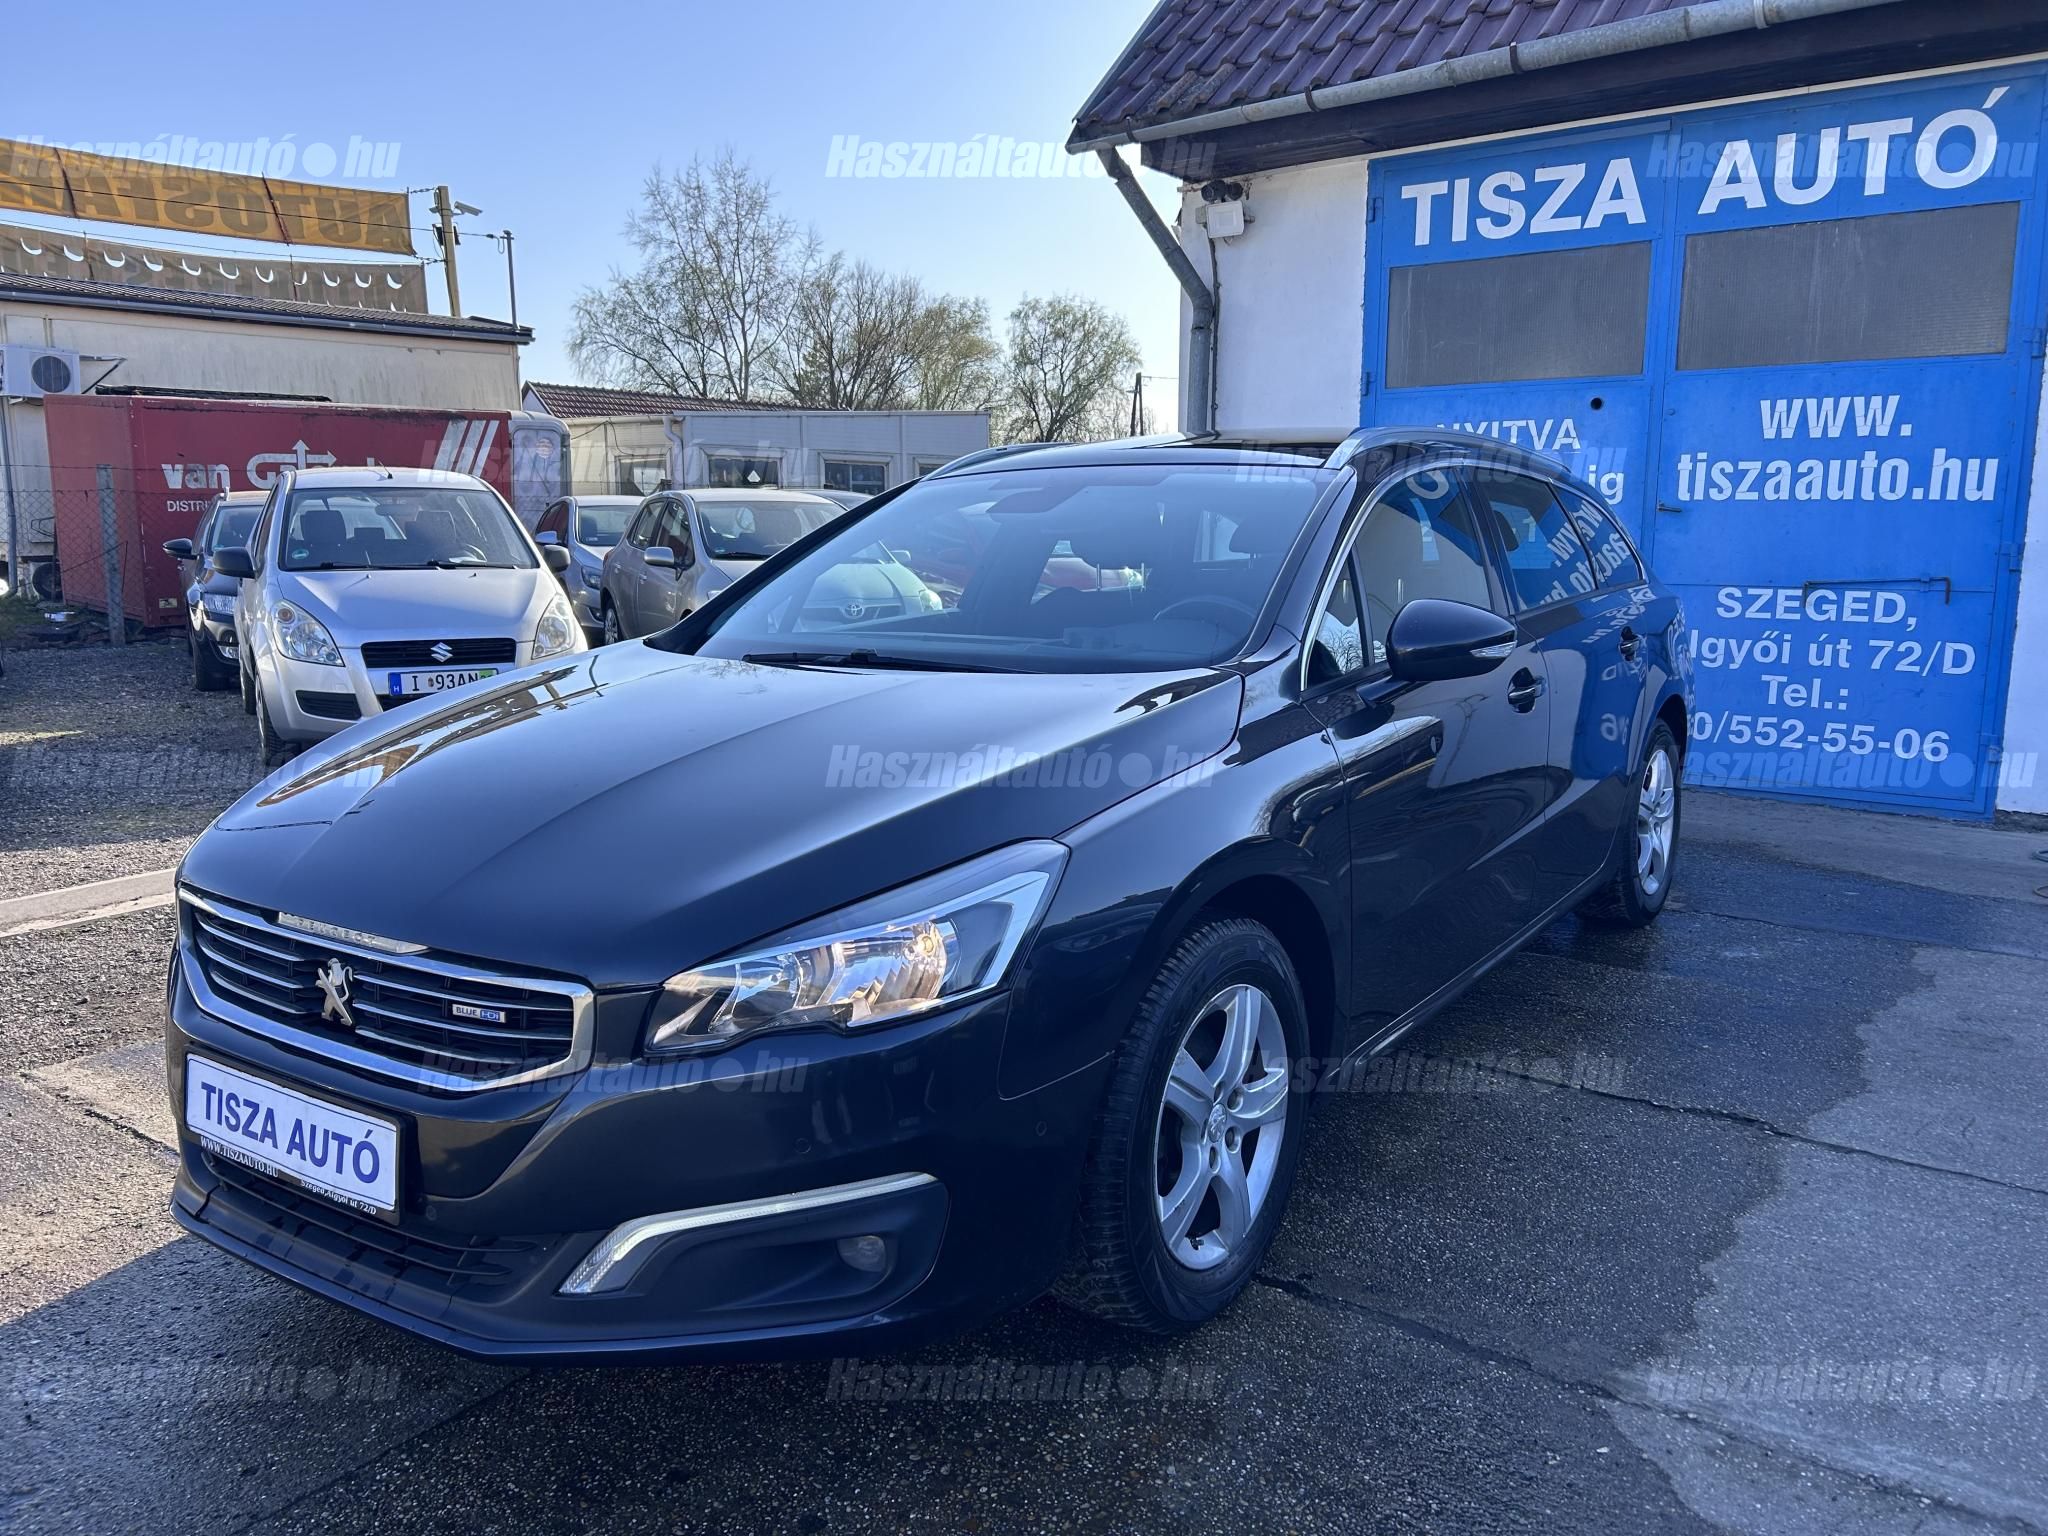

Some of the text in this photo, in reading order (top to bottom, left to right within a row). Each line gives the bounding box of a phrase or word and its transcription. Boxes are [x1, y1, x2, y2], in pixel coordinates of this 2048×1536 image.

[1401, 86, 2010, 246] TISZA AUTÓ
[161, 463, 230, 489] van
[1677, 448, 1999, 501] tiszaauto.hu
[1716, 587, 1918, 631] SZEGED,
[1689, 629, 1793, 670] lgyői
[1807, 633, 1852, 668] út
[1868, 639, 1977, 676] 72/D
[1761, 674, 1849, 710] Tel.:
[1692, 711, 1951, 763] 0/552-55-06
[201, 1081, 380, 1184] TISZA AUTÓ
